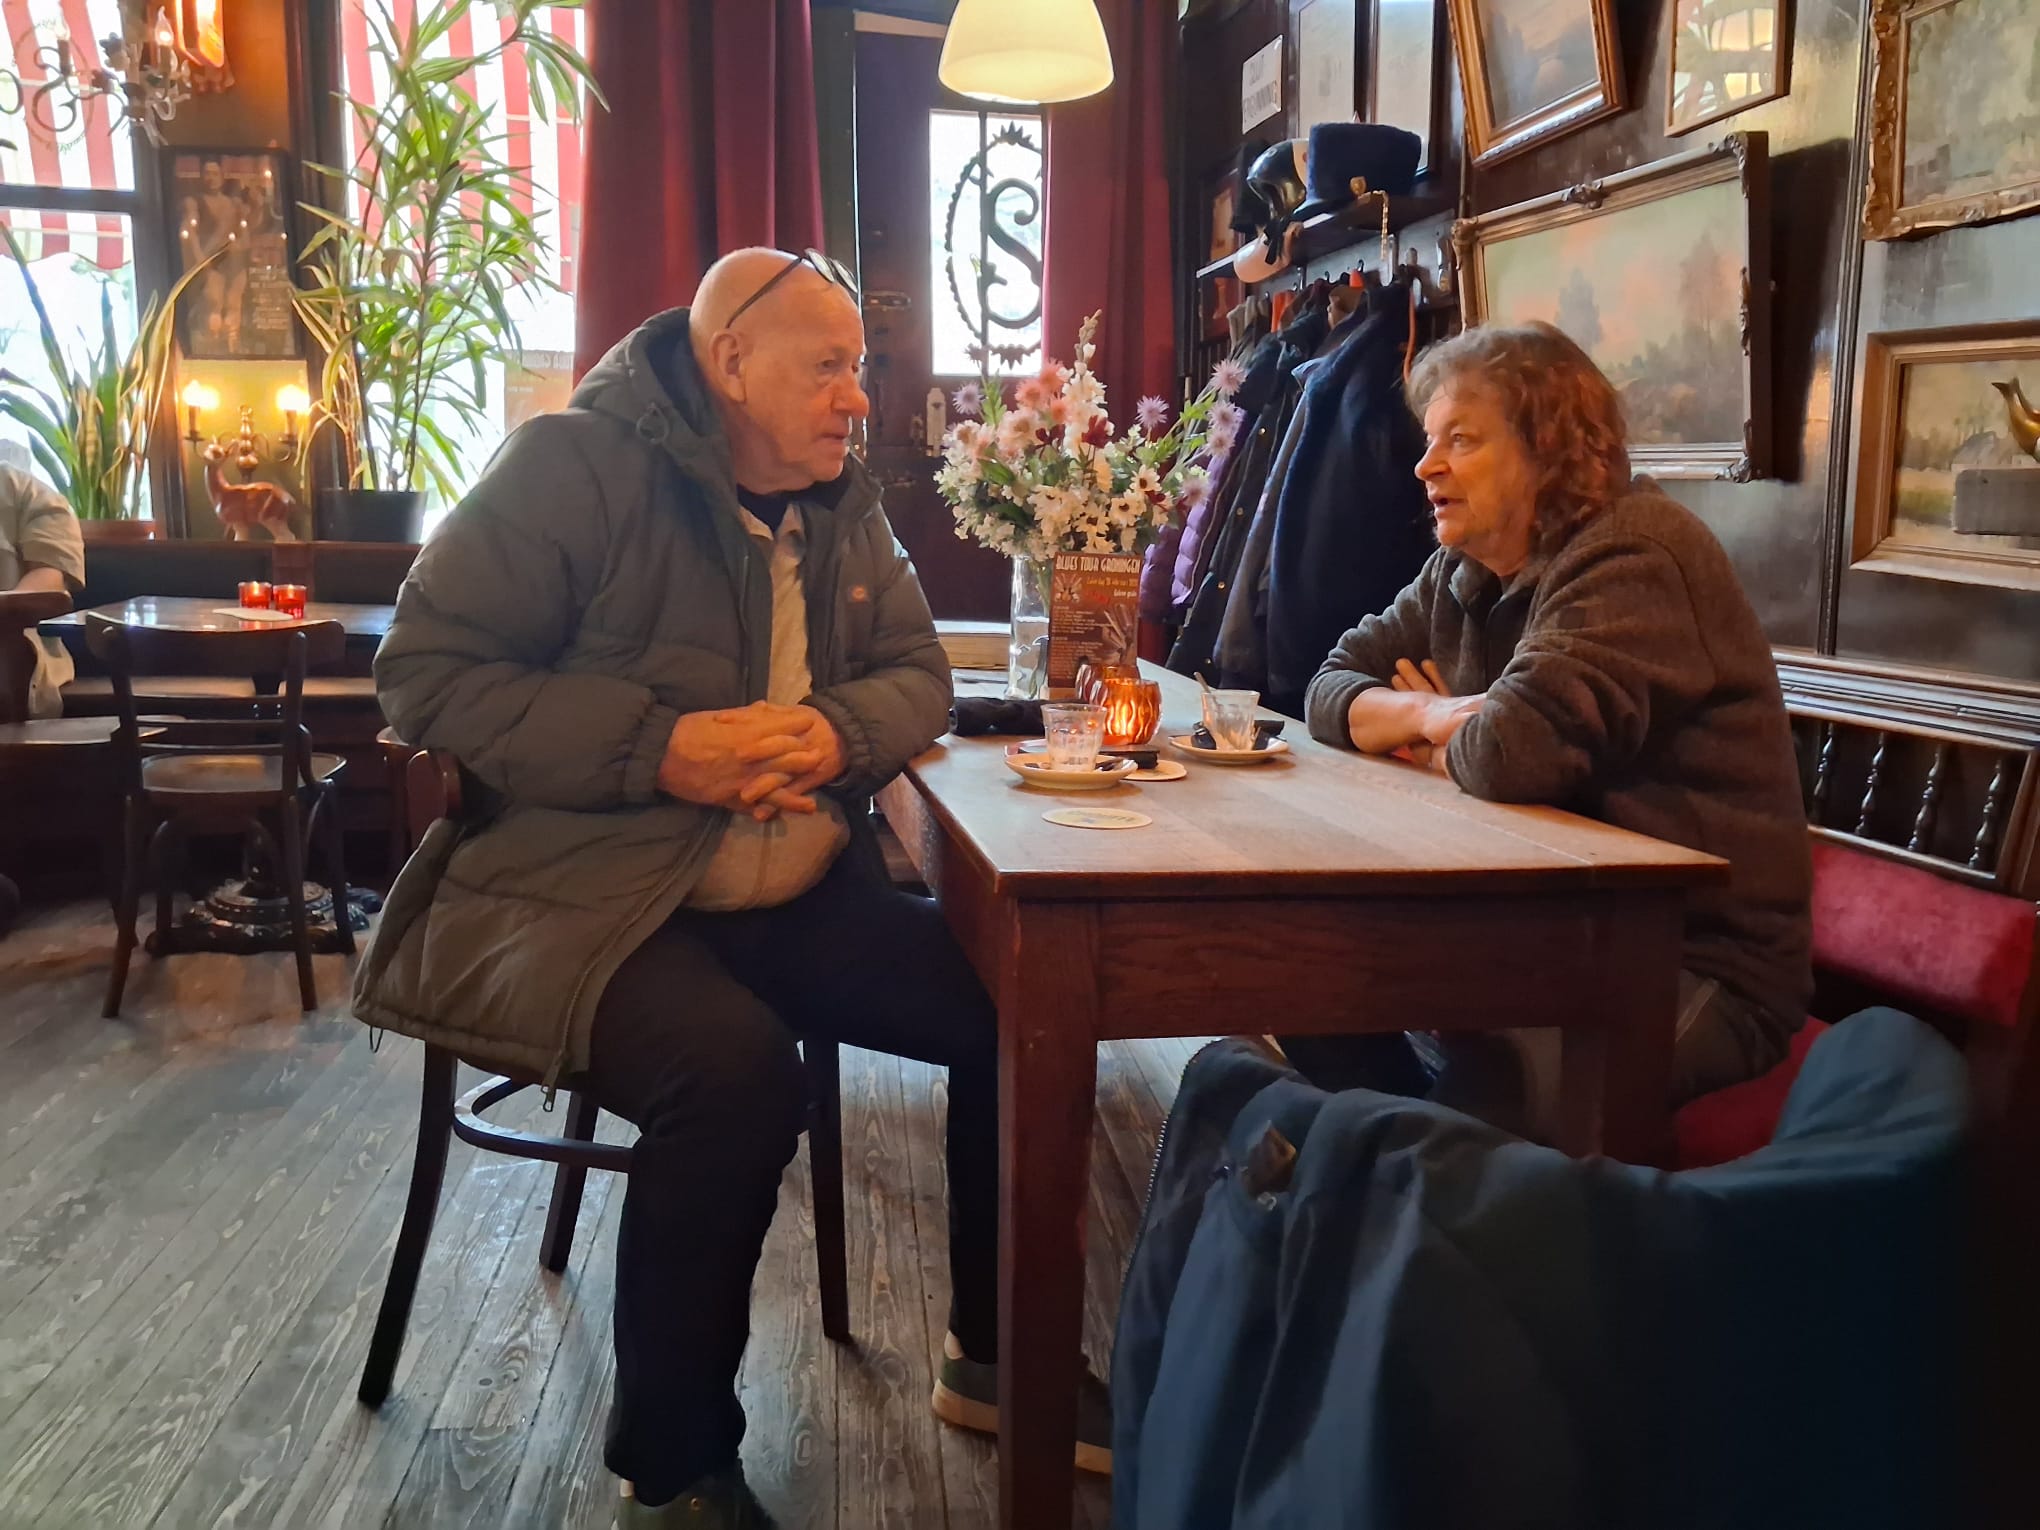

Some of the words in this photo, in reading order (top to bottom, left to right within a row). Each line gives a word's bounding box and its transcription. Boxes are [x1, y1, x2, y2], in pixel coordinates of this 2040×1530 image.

[1056, 555, 1078, 570] BLUES
[1081, 556, 1099, 571] TOUR
[1100, 557, 1140, 574] GRONINGEN
